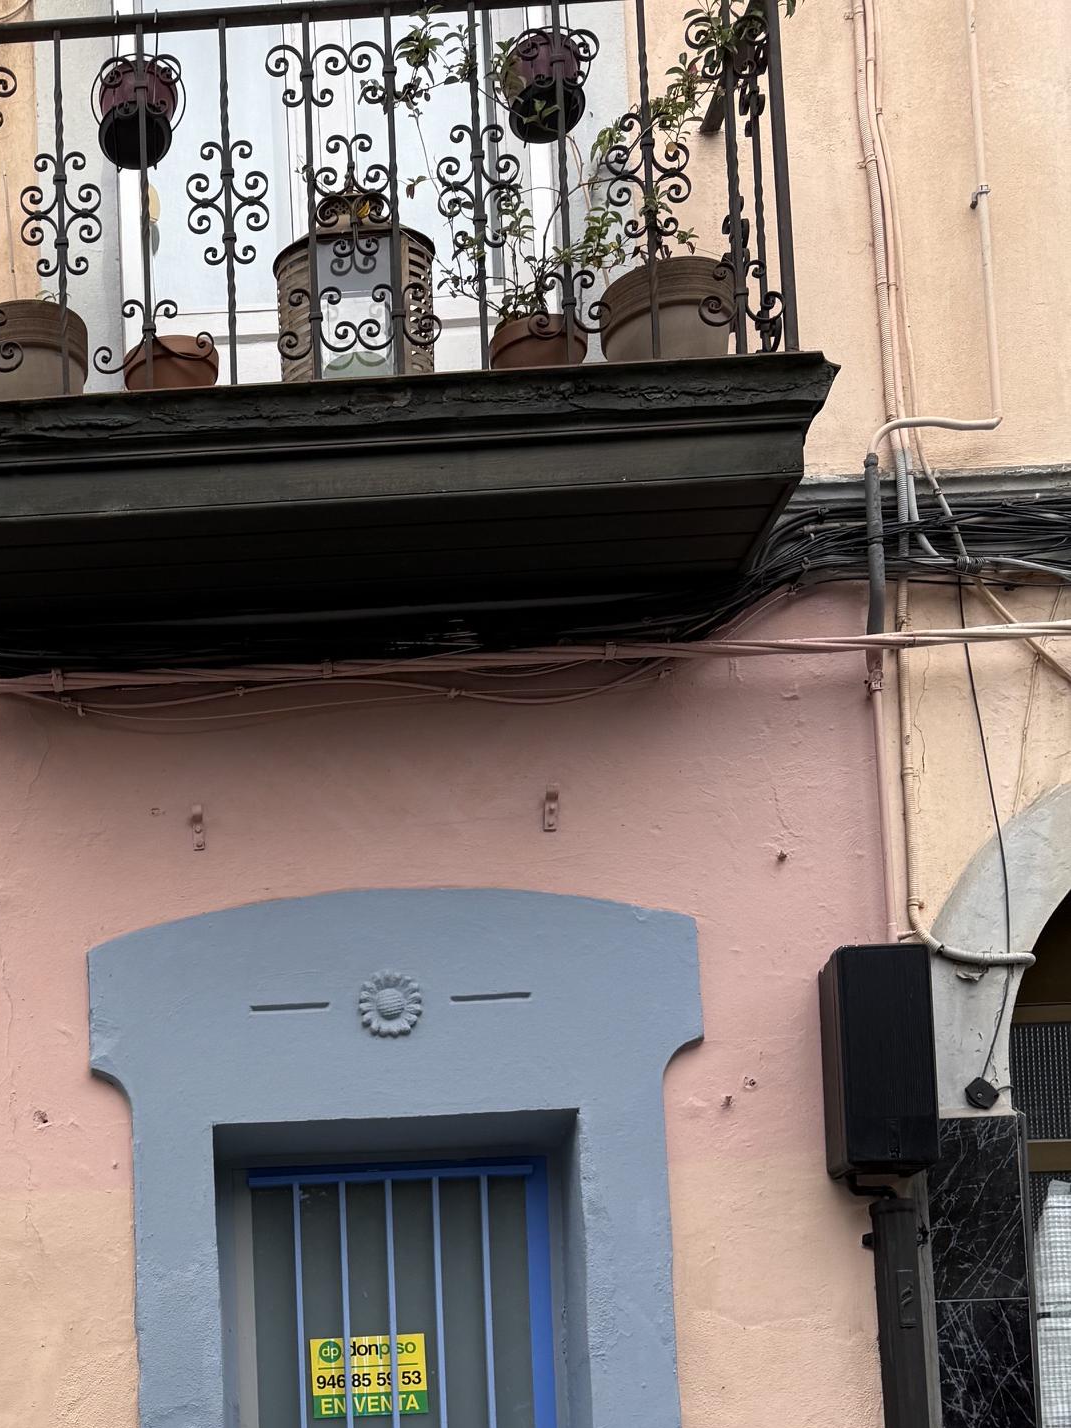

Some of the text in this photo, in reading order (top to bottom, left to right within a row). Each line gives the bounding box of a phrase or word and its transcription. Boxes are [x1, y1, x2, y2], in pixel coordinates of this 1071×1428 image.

[347, 1341, 417, 1359] donpso
[316, 1374, 346, 1389] 946
[351, 1373, 372, 1388] 85
[401, 1370, 422, 1385] 53
[321, 1394, 420, 1415] EN VENTA
